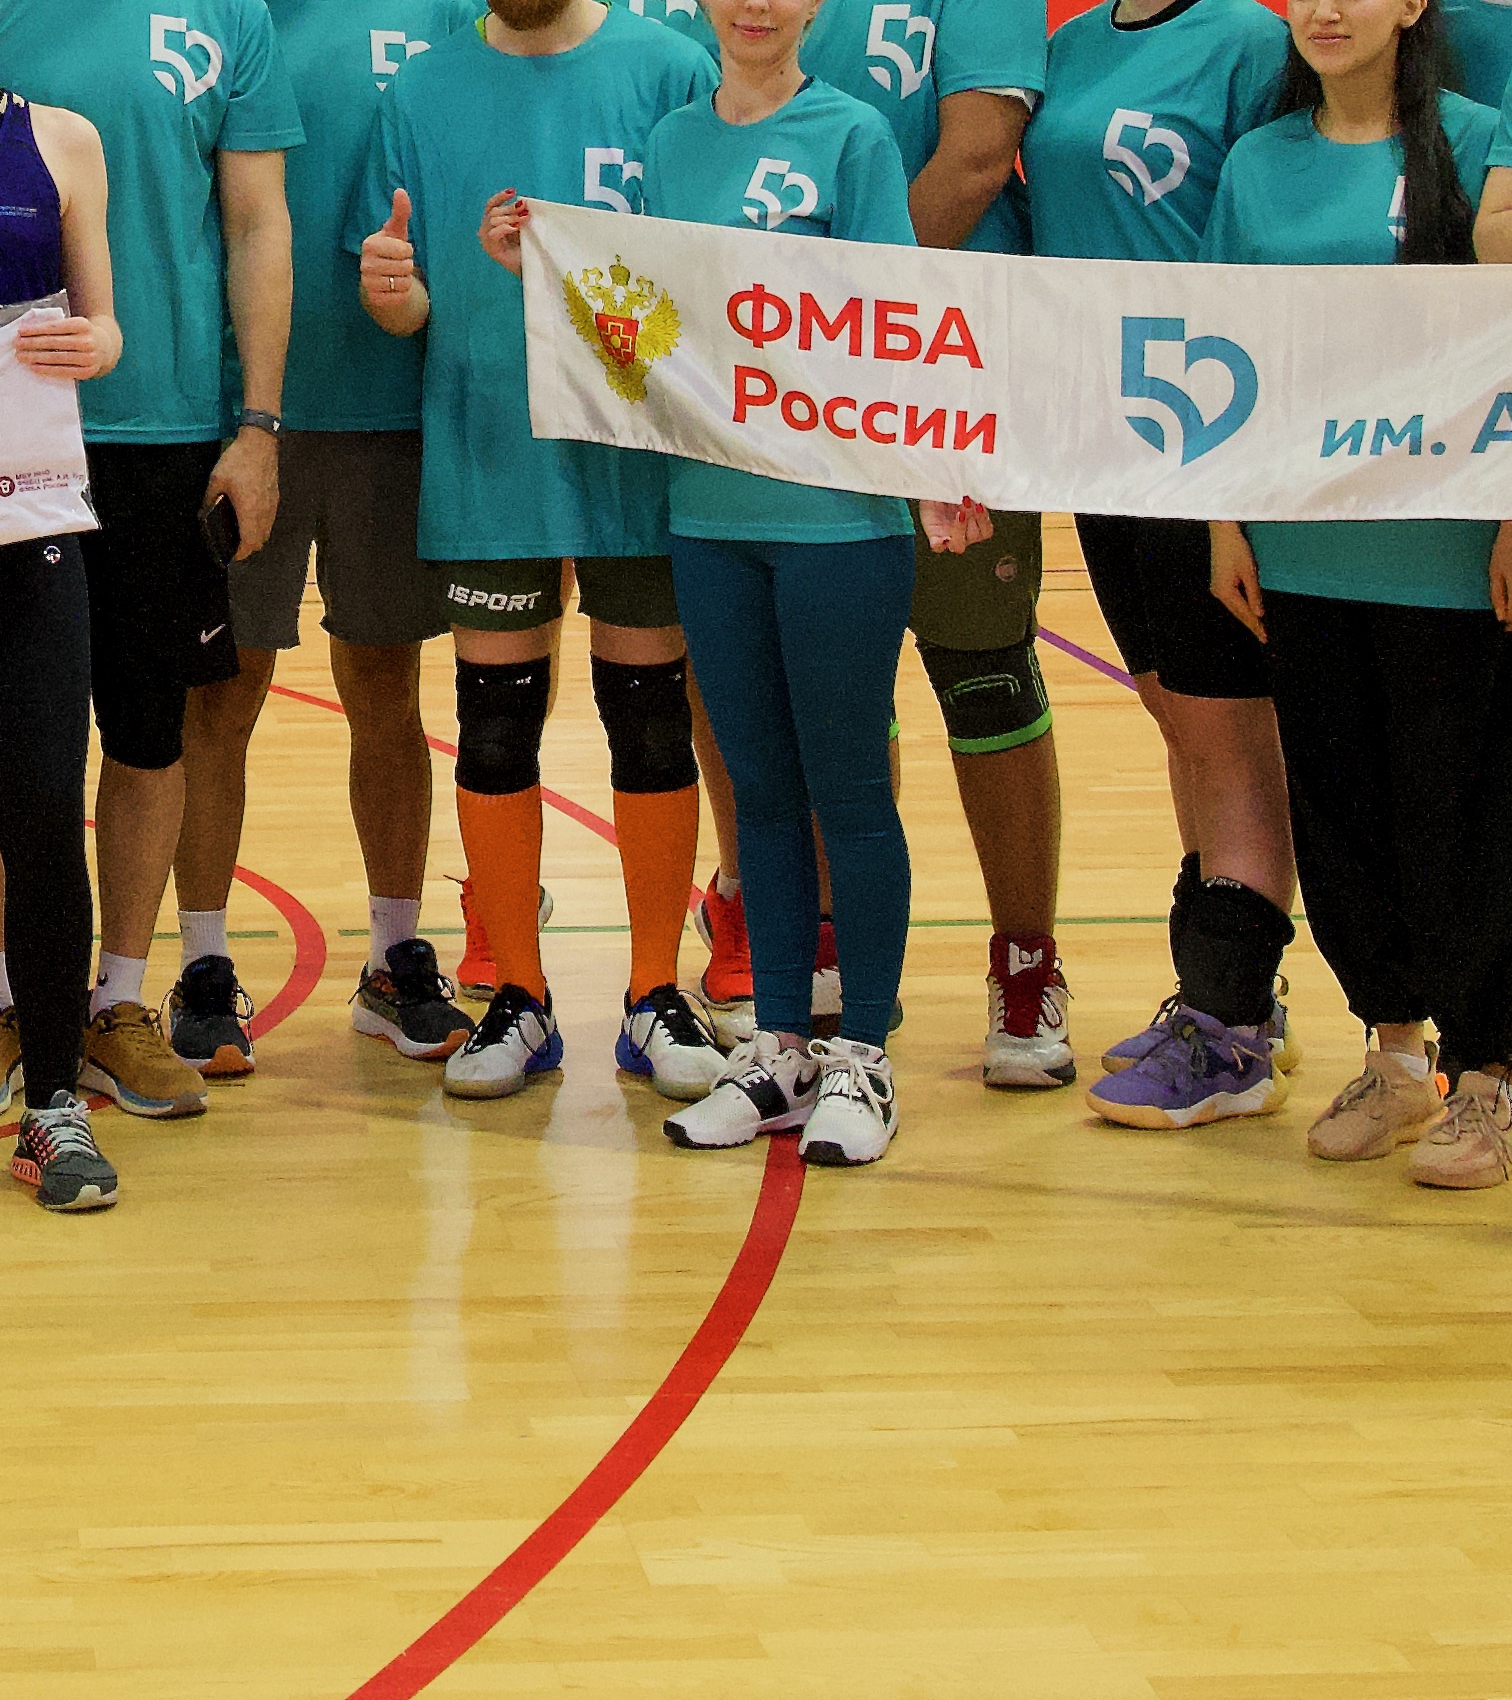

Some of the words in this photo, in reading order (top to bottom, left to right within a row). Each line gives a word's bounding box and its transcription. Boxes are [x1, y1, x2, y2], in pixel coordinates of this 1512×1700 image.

[726, 283, 985, 370] ФМБА
[731, 364, 998, 455] России
[1319, 413, 1447, 459] им.
